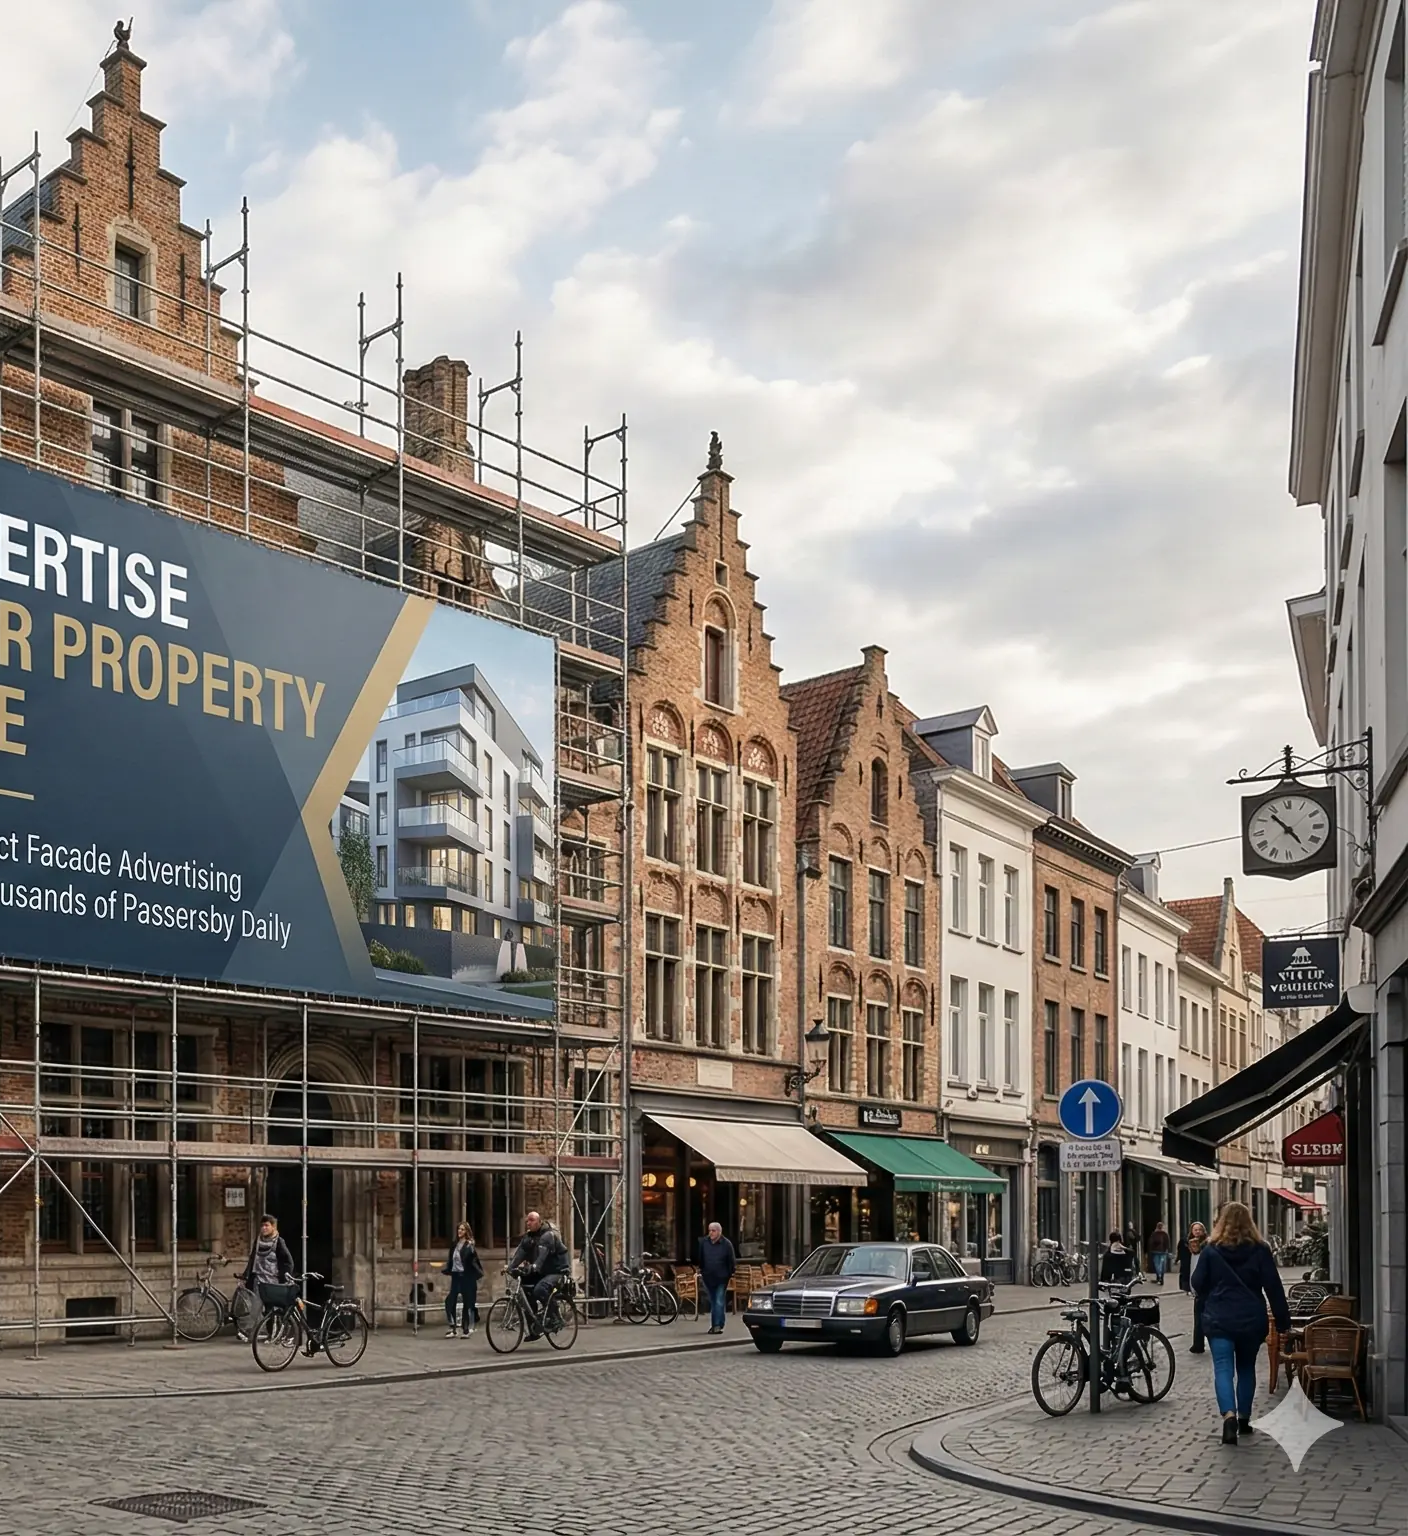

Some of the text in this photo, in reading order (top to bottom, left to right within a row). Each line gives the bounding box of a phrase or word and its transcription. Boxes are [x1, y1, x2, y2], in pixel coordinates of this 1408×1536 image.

[53, 613, 326, 740] PROPERTY
[27, 833, 111, 876] Facade
[118, 849, 241, 902] Advertising
[94, 890, 118, 920] of
[123, 892, 235, 942] Passersby
[242, 909, 291, 949] Daily
